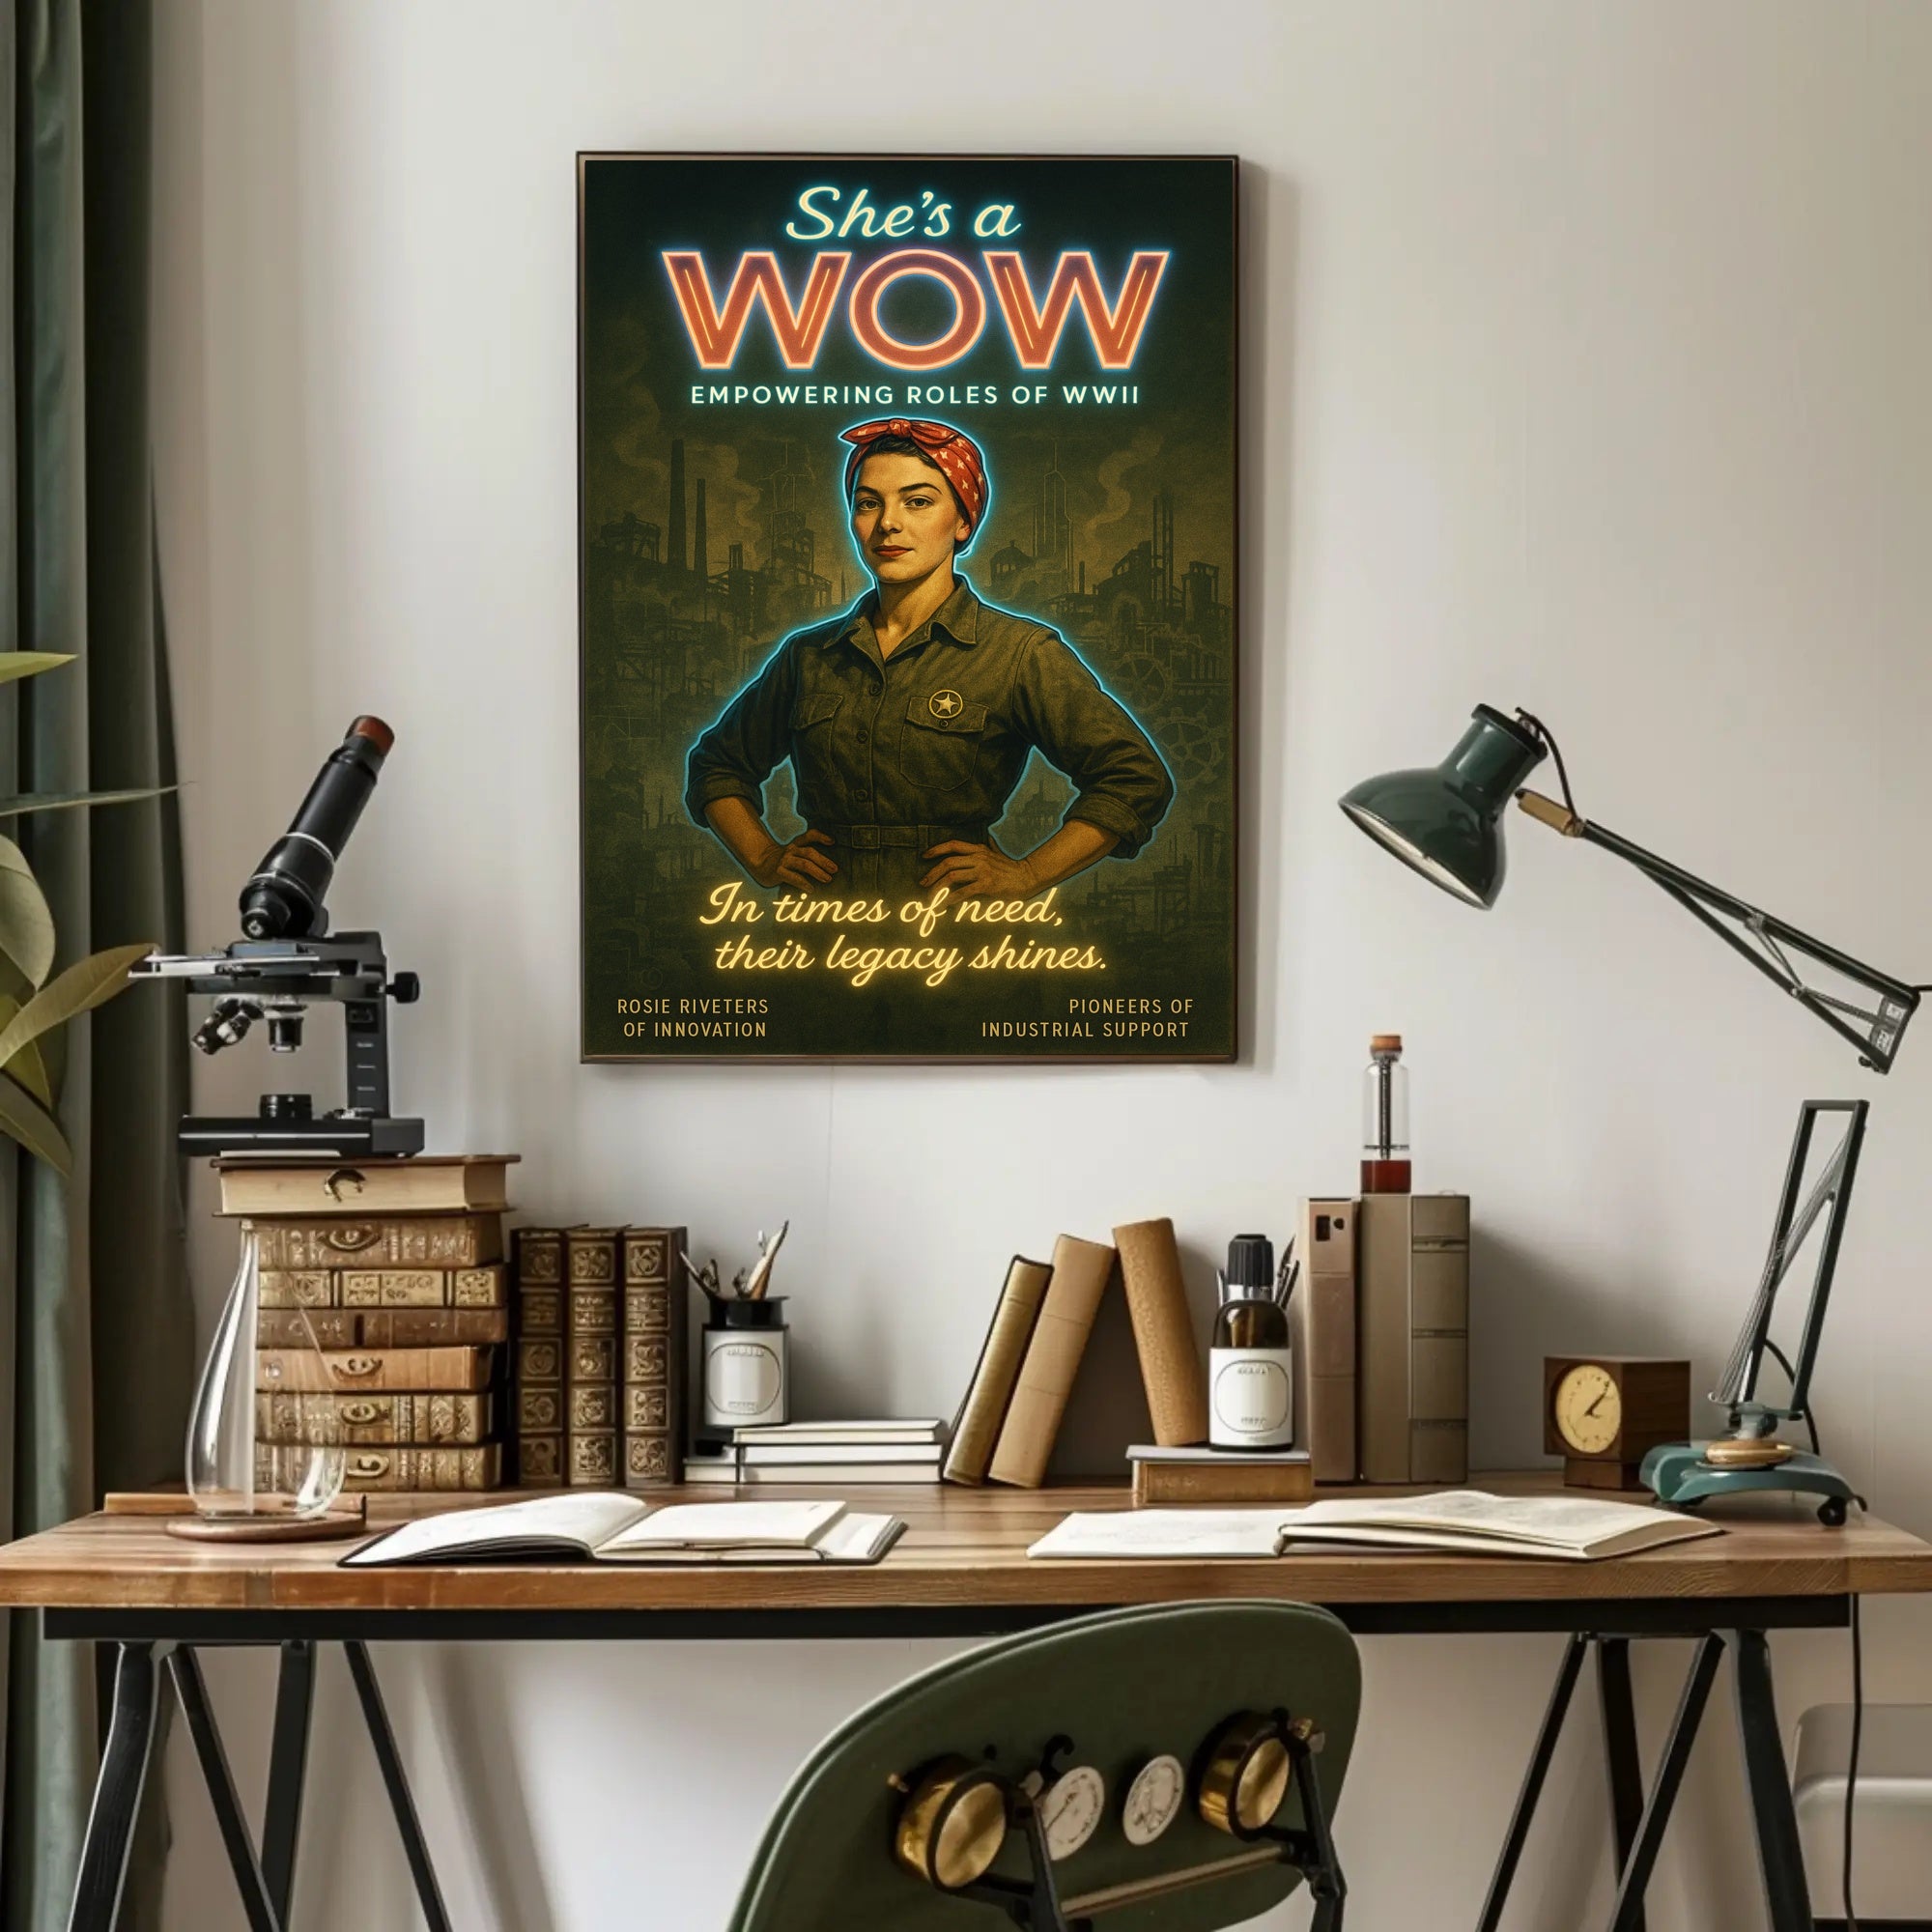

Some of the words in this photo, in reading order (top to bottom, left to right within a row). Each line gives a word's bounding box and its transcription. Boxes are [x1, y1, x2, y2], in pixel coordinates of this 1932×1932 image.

[786, 186, 952, 240] She's
[974, 205, 1021, 237] a
[662, 249, 1170, 371] WOW
[691, 385, 894, 405] EMPOWERING
[907, 385, 998, 405] ROLES
[1011, 385, 1048, 405] OF
[1062, 385, 1138, 404] WWII
[699, 882, 764, 923] In
[773, 894, 891, 922] times
[900, 888, 950, 937] of
[955, 888, 1062, 925] need,
[716, 935, 814, 969] their
[827, 935, 963, 986] legacy
[968, 935, 1105, 969] shines.
[617, 999, 670, 1014] ROSIE
[680, 998, 768, 1014] RIVETERS
[1069, 998, 1162, 1014] PIONEERS
[1170, 999, 1194, 1014] OF
[623, 1022, 646, 1037] OF
[654, 1021, 766, 1037] INNOVATION
[982, 1021, 1094, 1037] INDUSTRIAL
[1102, 1022, 1189, 1037] SUPPORT
